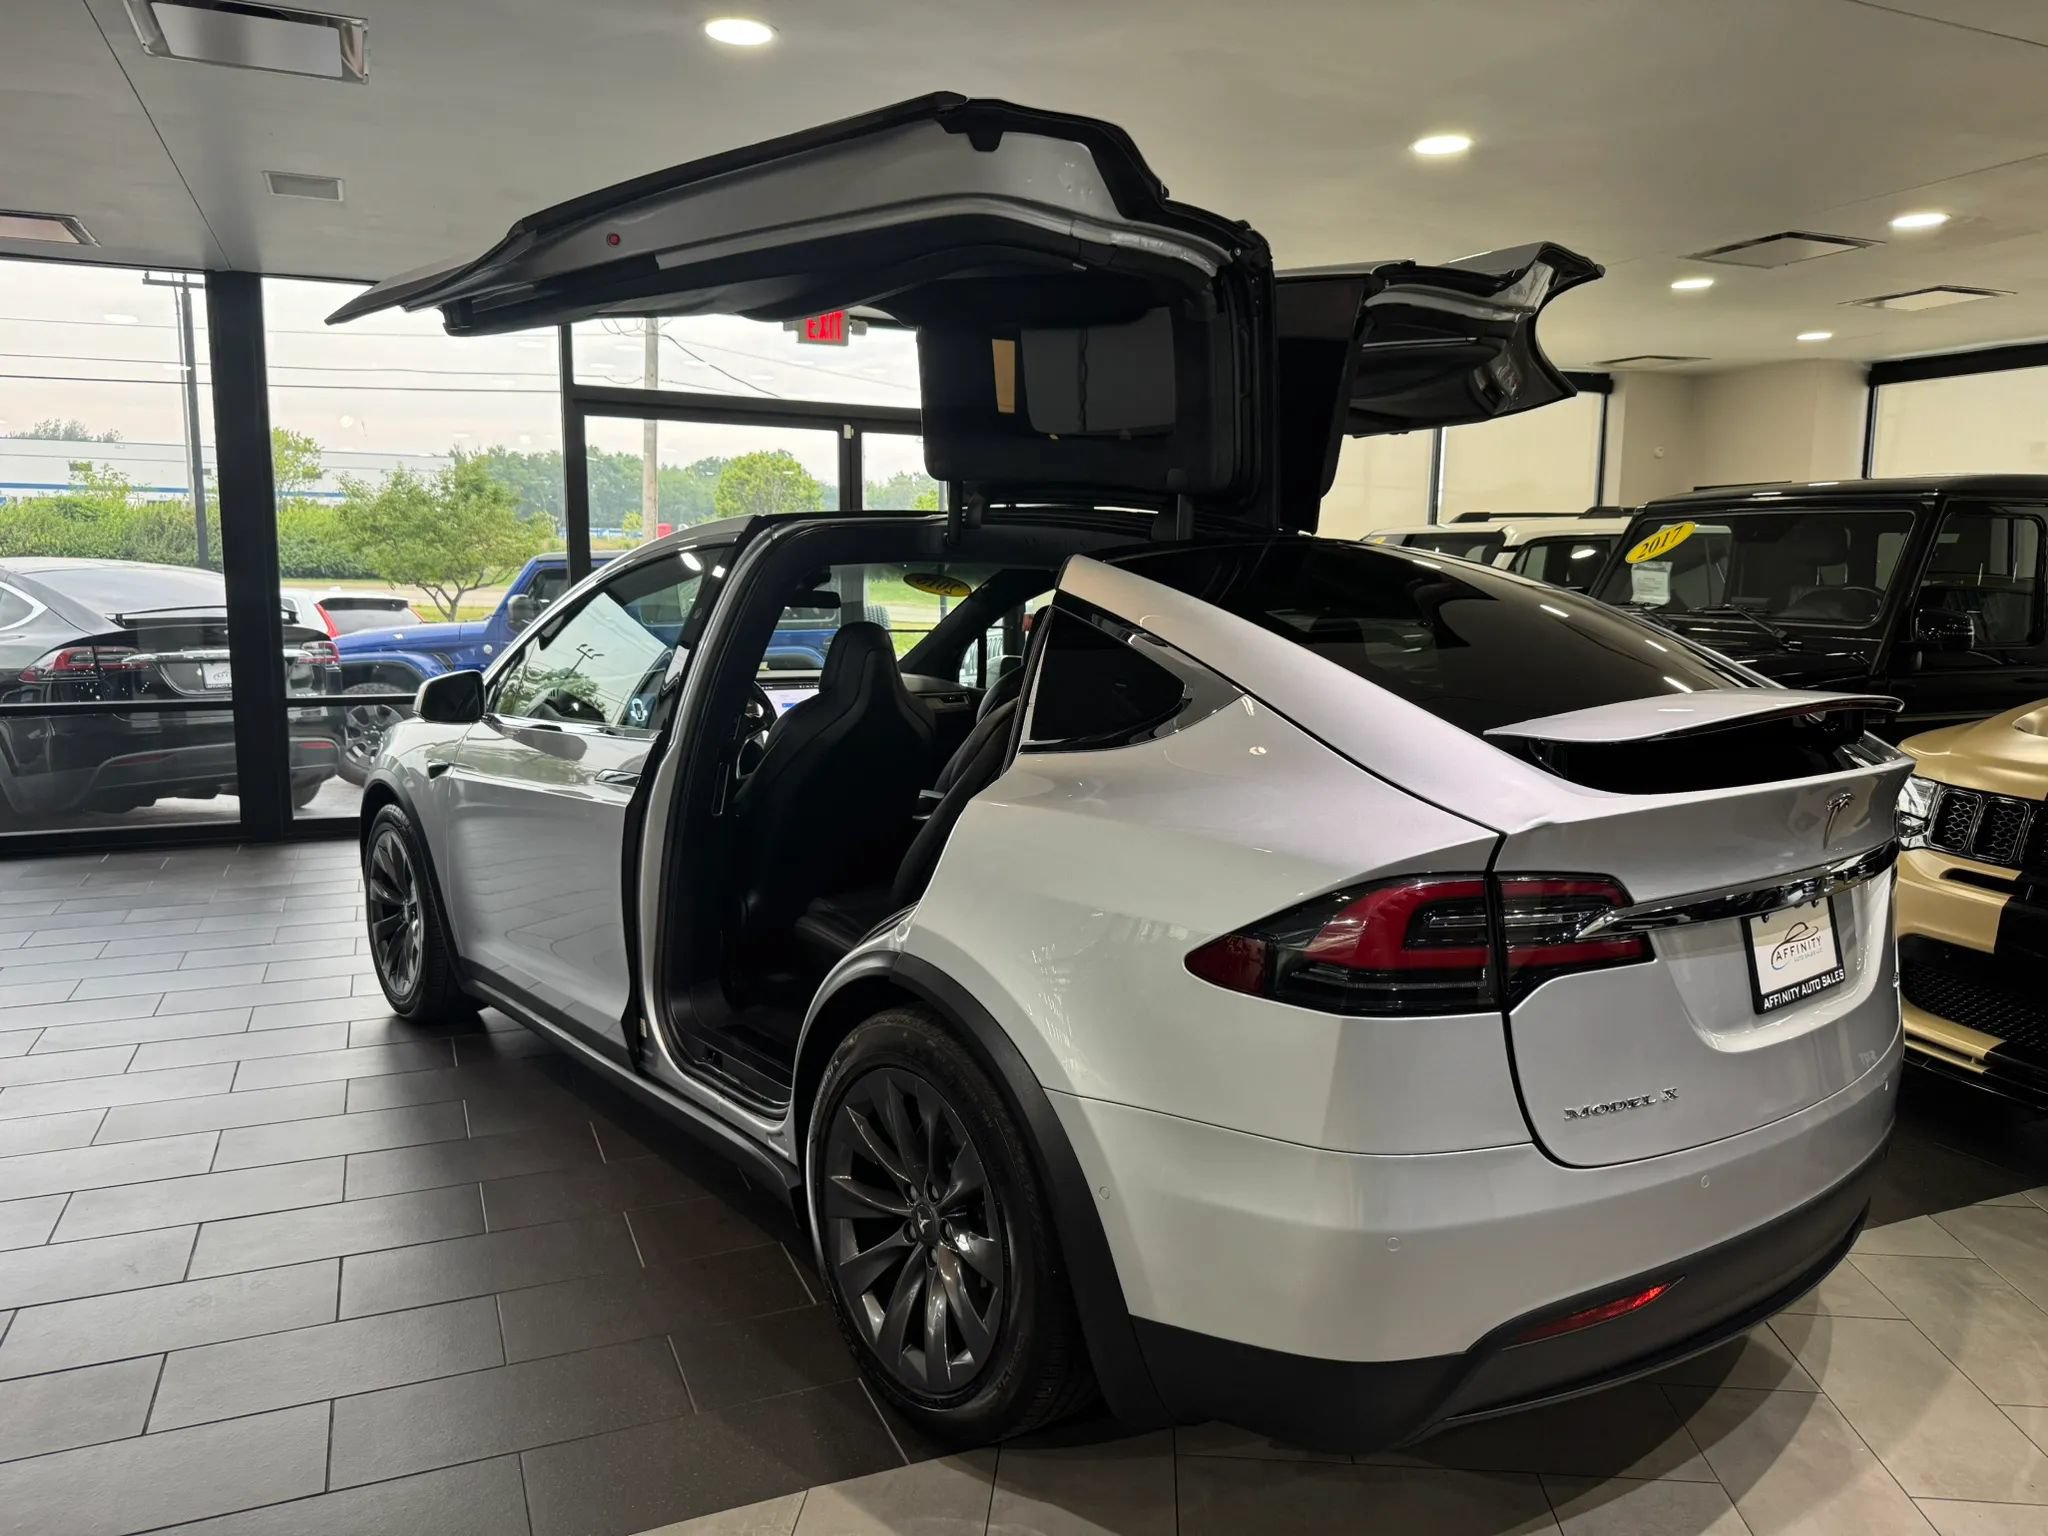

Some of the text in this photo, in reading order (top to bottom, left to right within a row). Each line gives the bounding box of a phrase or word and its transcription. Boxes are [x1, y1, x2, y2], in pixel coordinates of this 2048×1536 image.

[806, 311, 844, 342] EXIT
[1637, 525, 1684, 559] 2017
[1775, 935, 1822, 962] AFFINITY
[1763, 968, 1845, 1010] AFFINITY AUTO SALES
[1563, 1087, 1679, 1121] MODEL X
